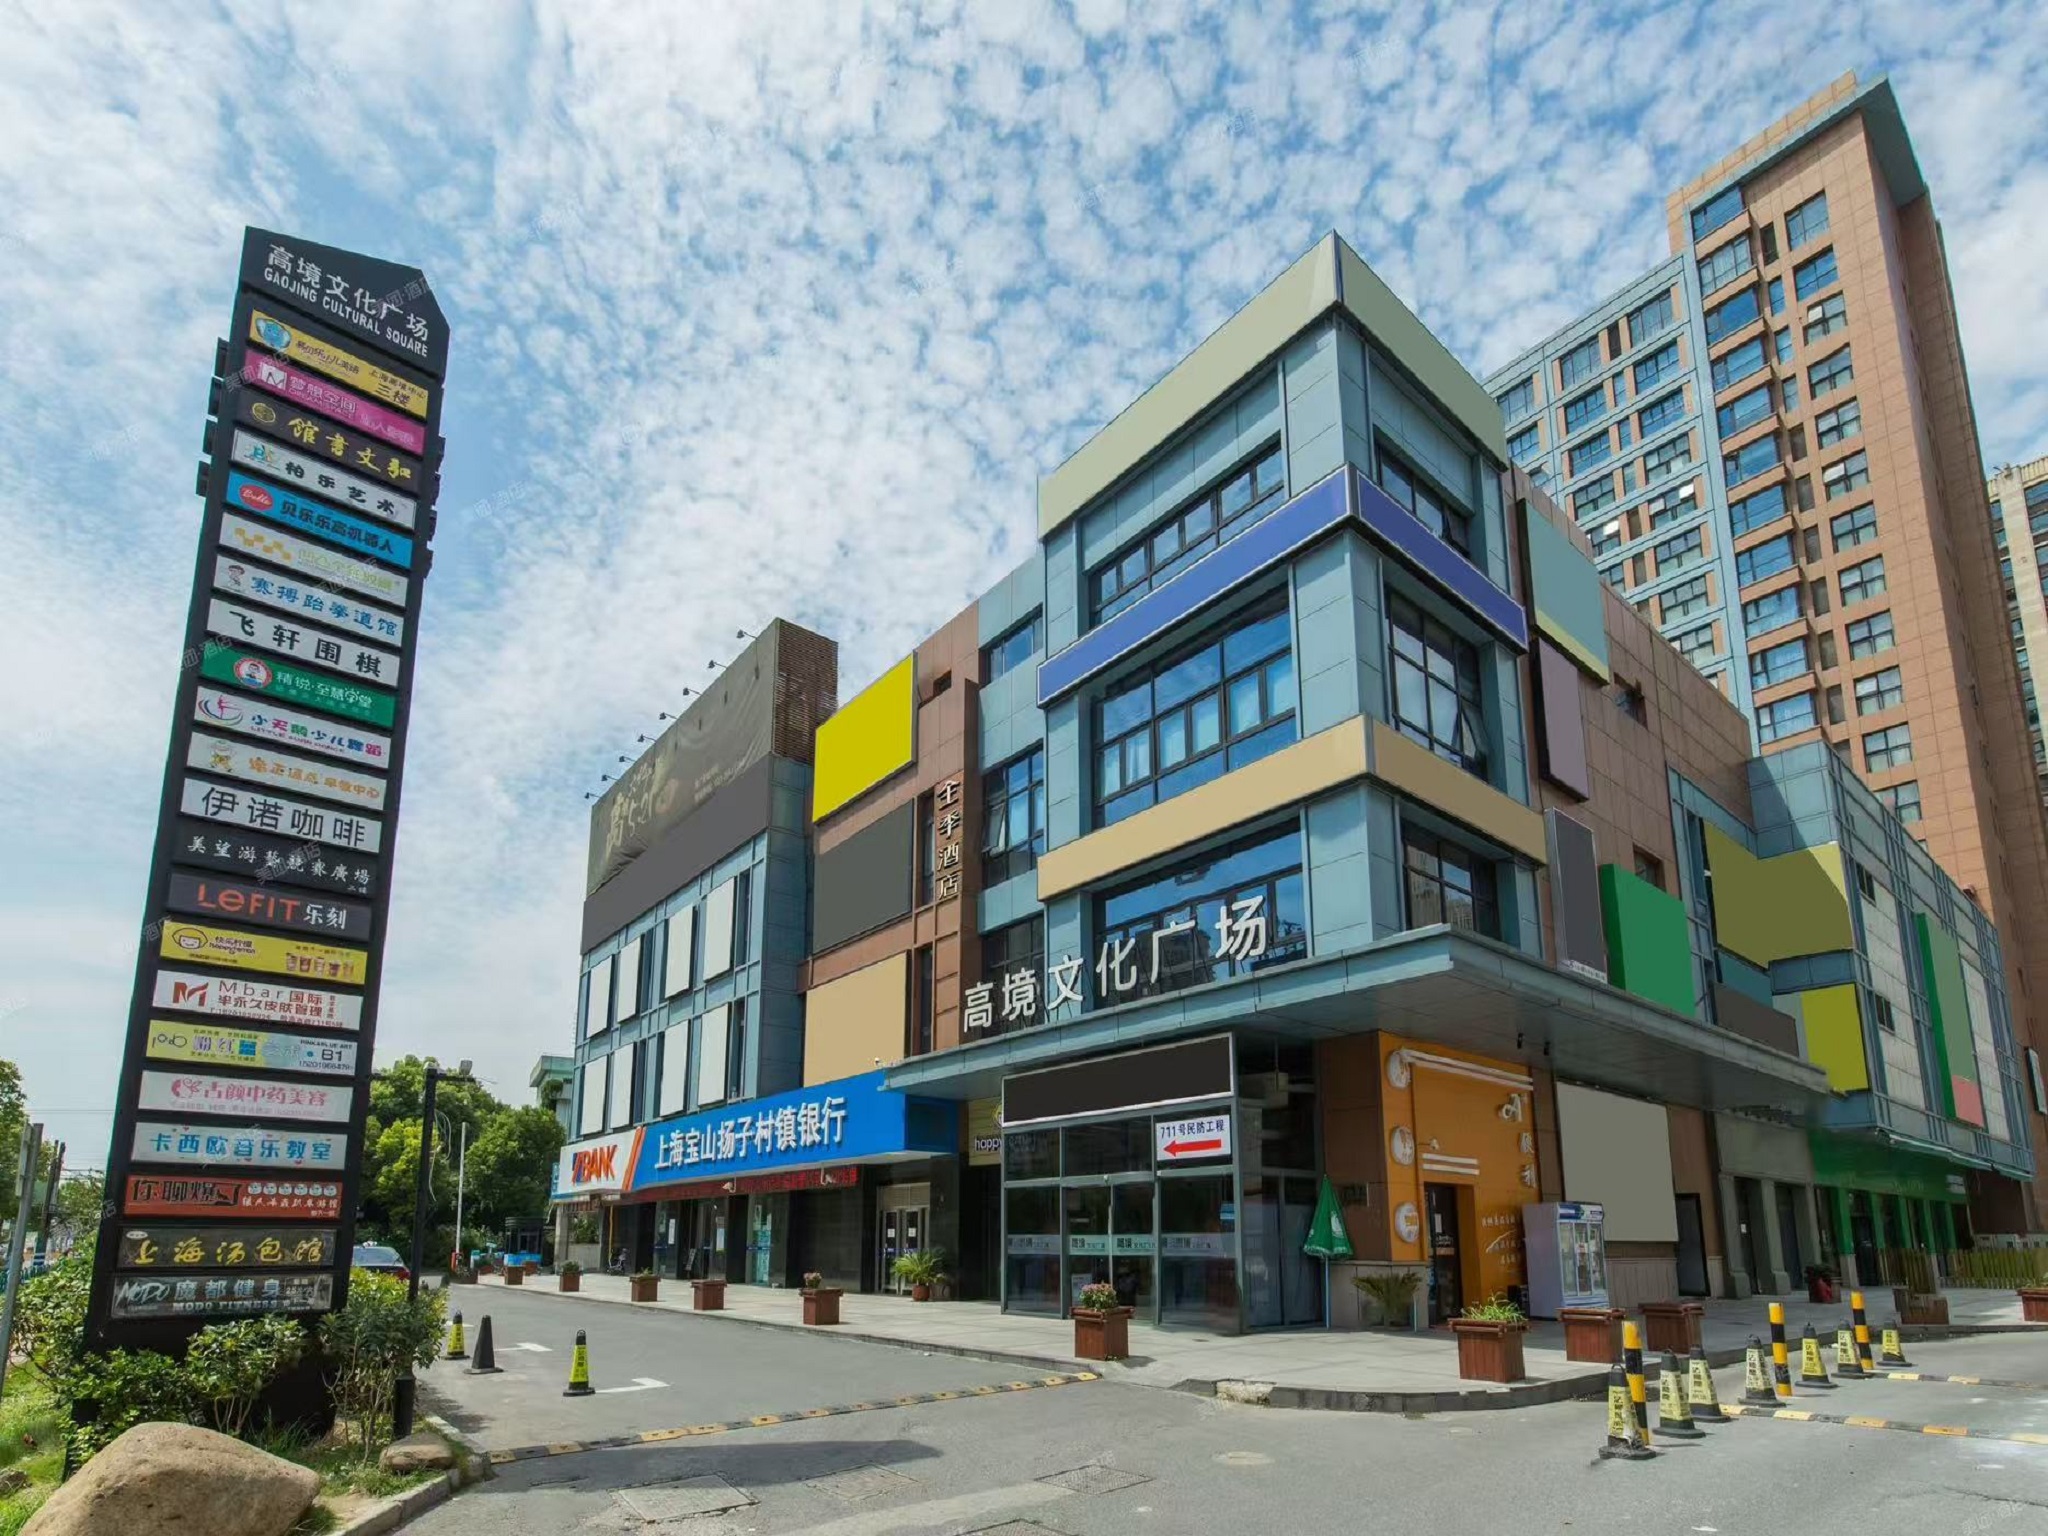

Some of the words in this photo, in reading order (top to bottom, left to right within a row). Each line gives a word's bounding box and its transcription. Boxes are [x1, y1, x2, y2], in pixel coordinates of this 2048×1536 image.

[264, 266, 318, 303] GAOJING
[323, 295, 380, 336] CULTURAL
[386, 326, 428, 358] SQUARE
[268, 244, 429, 341] 高境文化广场
[229, 609, 382, 678] 飞轩围棋
[201, 786, 366, 848] 伊诺咖啡
[936, 779, 961, 901] 全季酒店
[304, 903, 347, 930] 乐刻
[963, 895, 1267, 1034] 高境文化广场
[218, 995, 323, 1017] 半永久皮肤管理
[149, 1133, 333, 1161] 卡西欧音乐教室
[655, 1096, 849, 1170] 上海宝山扬子村镇银行
[1160, 1119, 1225, 1140] 711号民防工程
[134, 1236, 324, 1265] 上海汤包馆
[174, 1278, 281, 1300] 魔都健身
